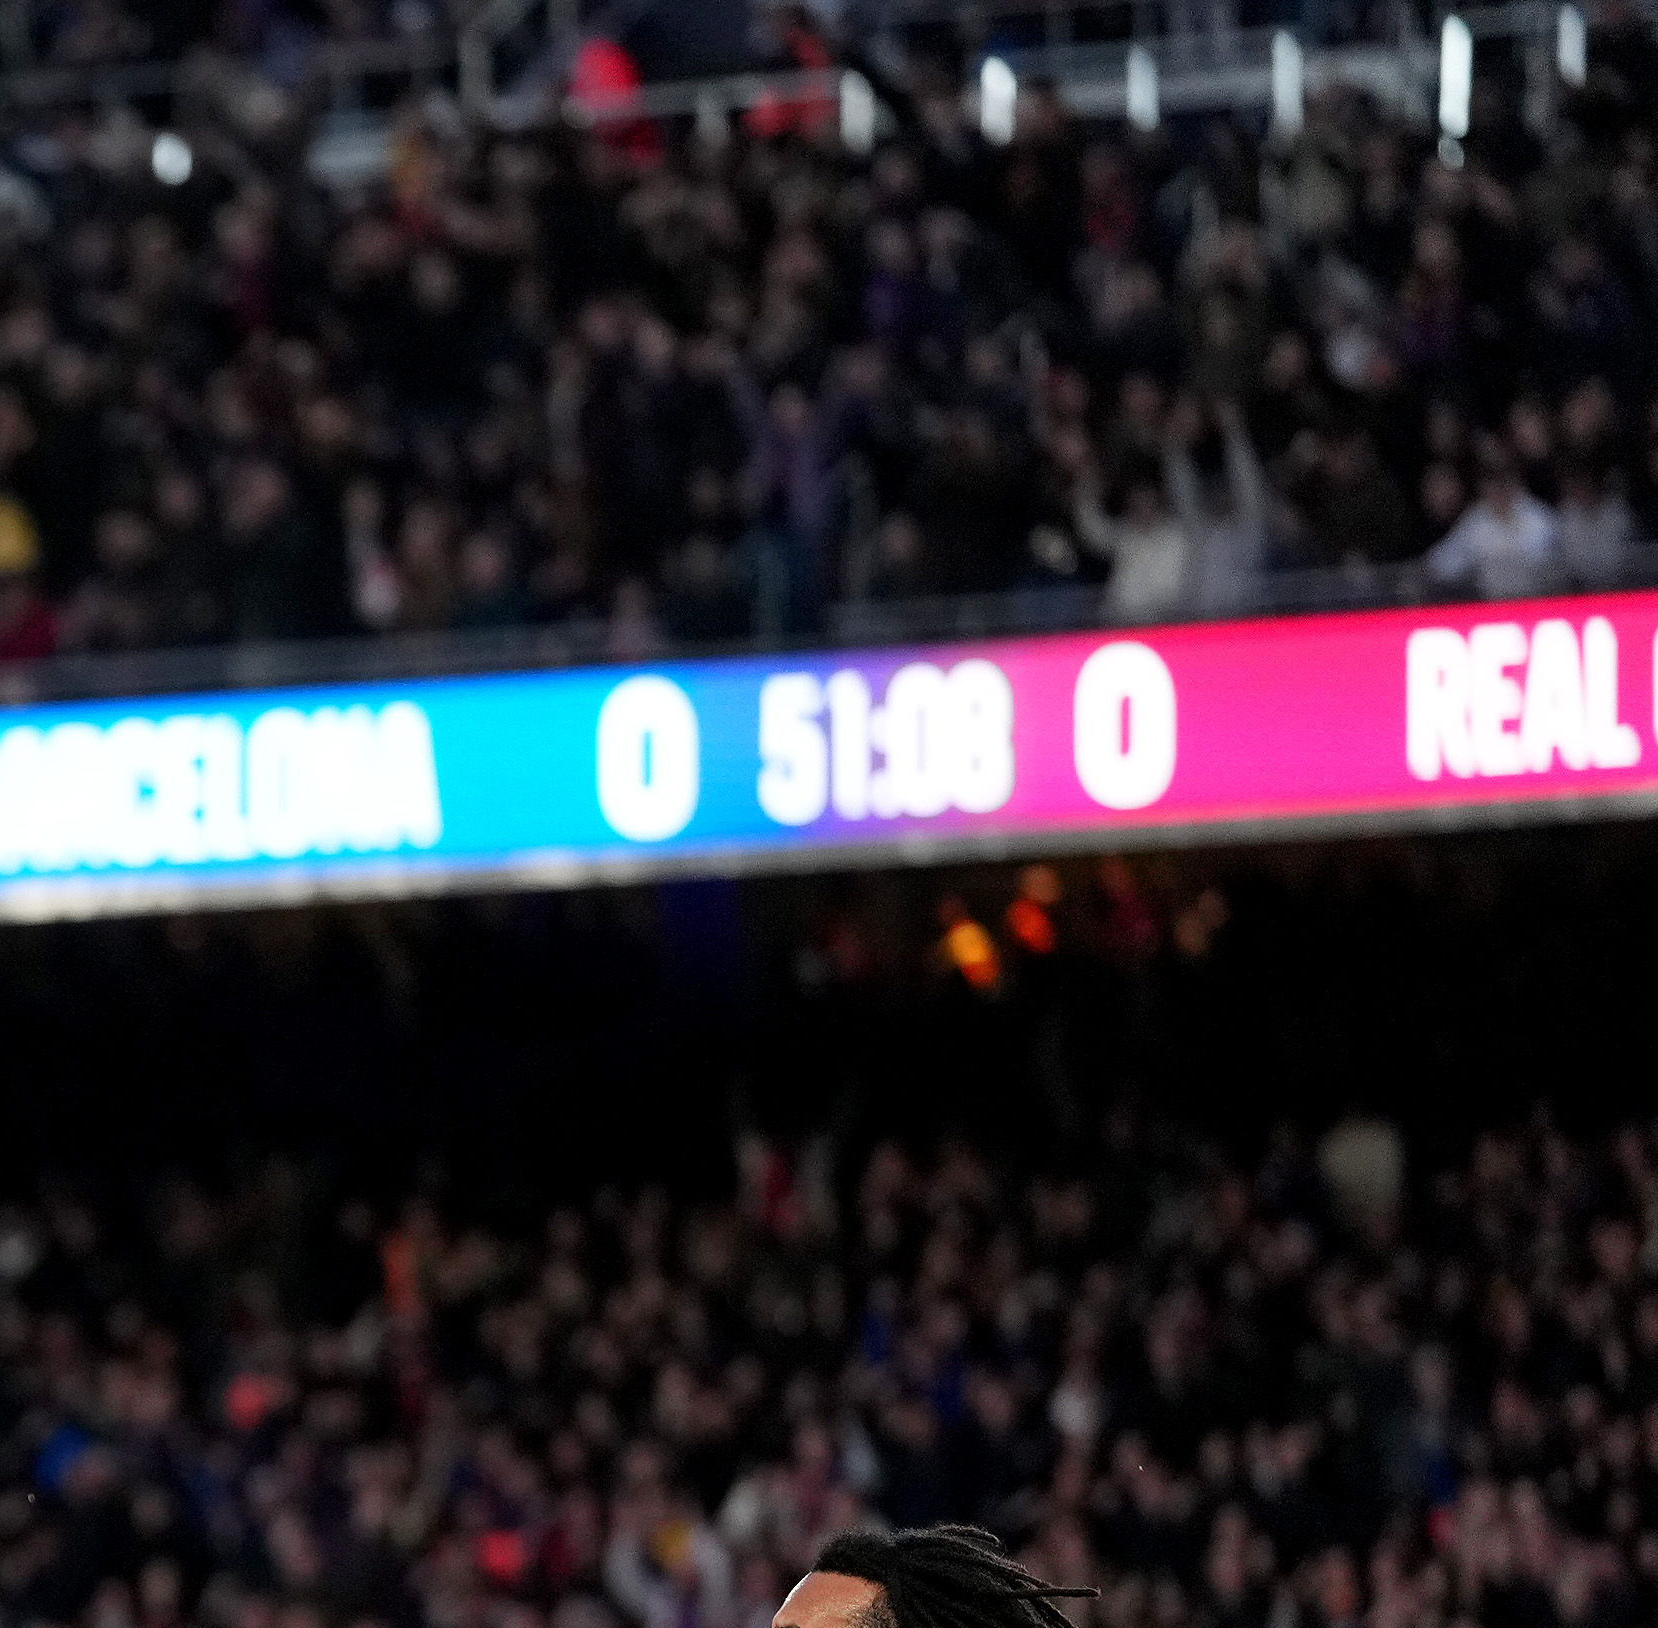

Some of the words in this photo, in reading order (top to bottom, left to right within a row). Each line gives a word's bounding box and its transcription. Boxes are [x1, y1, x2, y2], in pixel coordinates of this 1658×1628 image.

[597, 675, 700, 842] 0
[1073, 641, 1177, 810] 0
[1405, 616, 1641, 782] REAL
